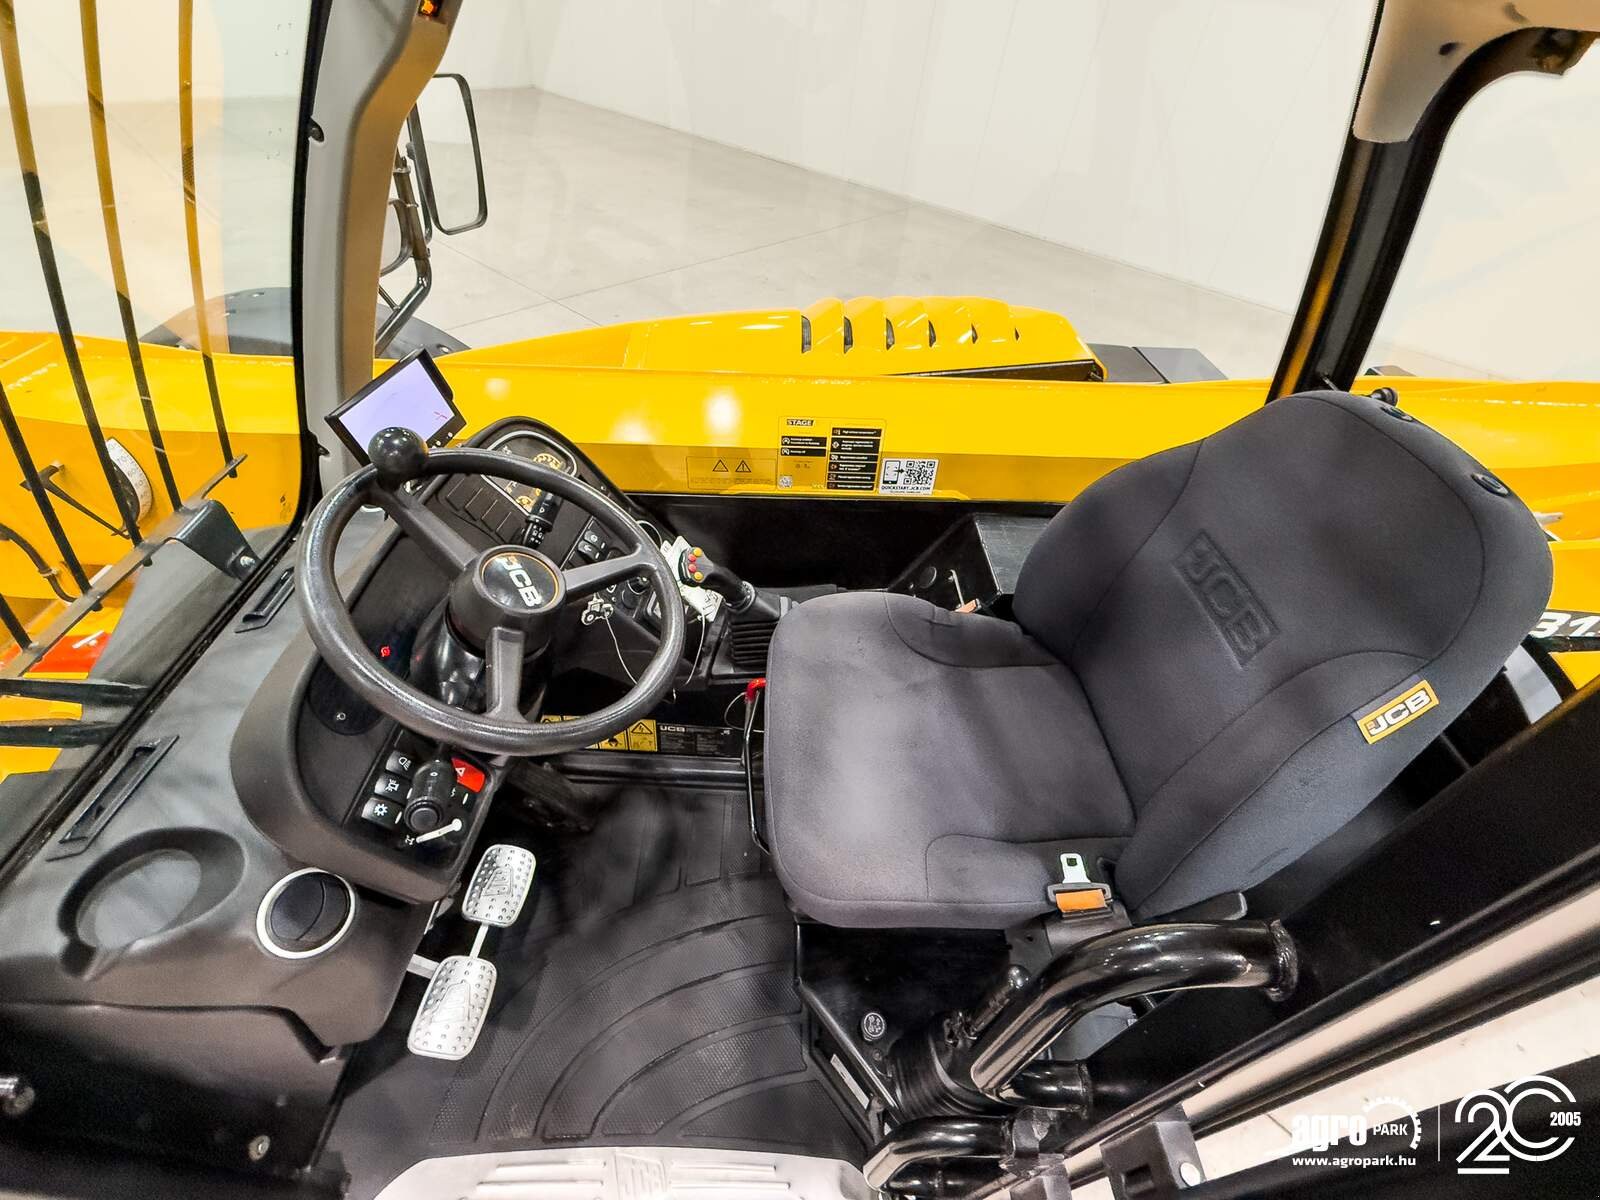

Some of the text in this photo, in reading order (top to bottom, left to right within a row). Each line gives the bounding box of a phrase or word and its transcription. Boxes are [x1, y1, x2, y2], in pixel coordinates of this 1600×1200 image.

[494, 556, 542, 607] JCB
[1181, 540, 1271, 652] JCB
[1366, 690, 1431, 737] JCB
